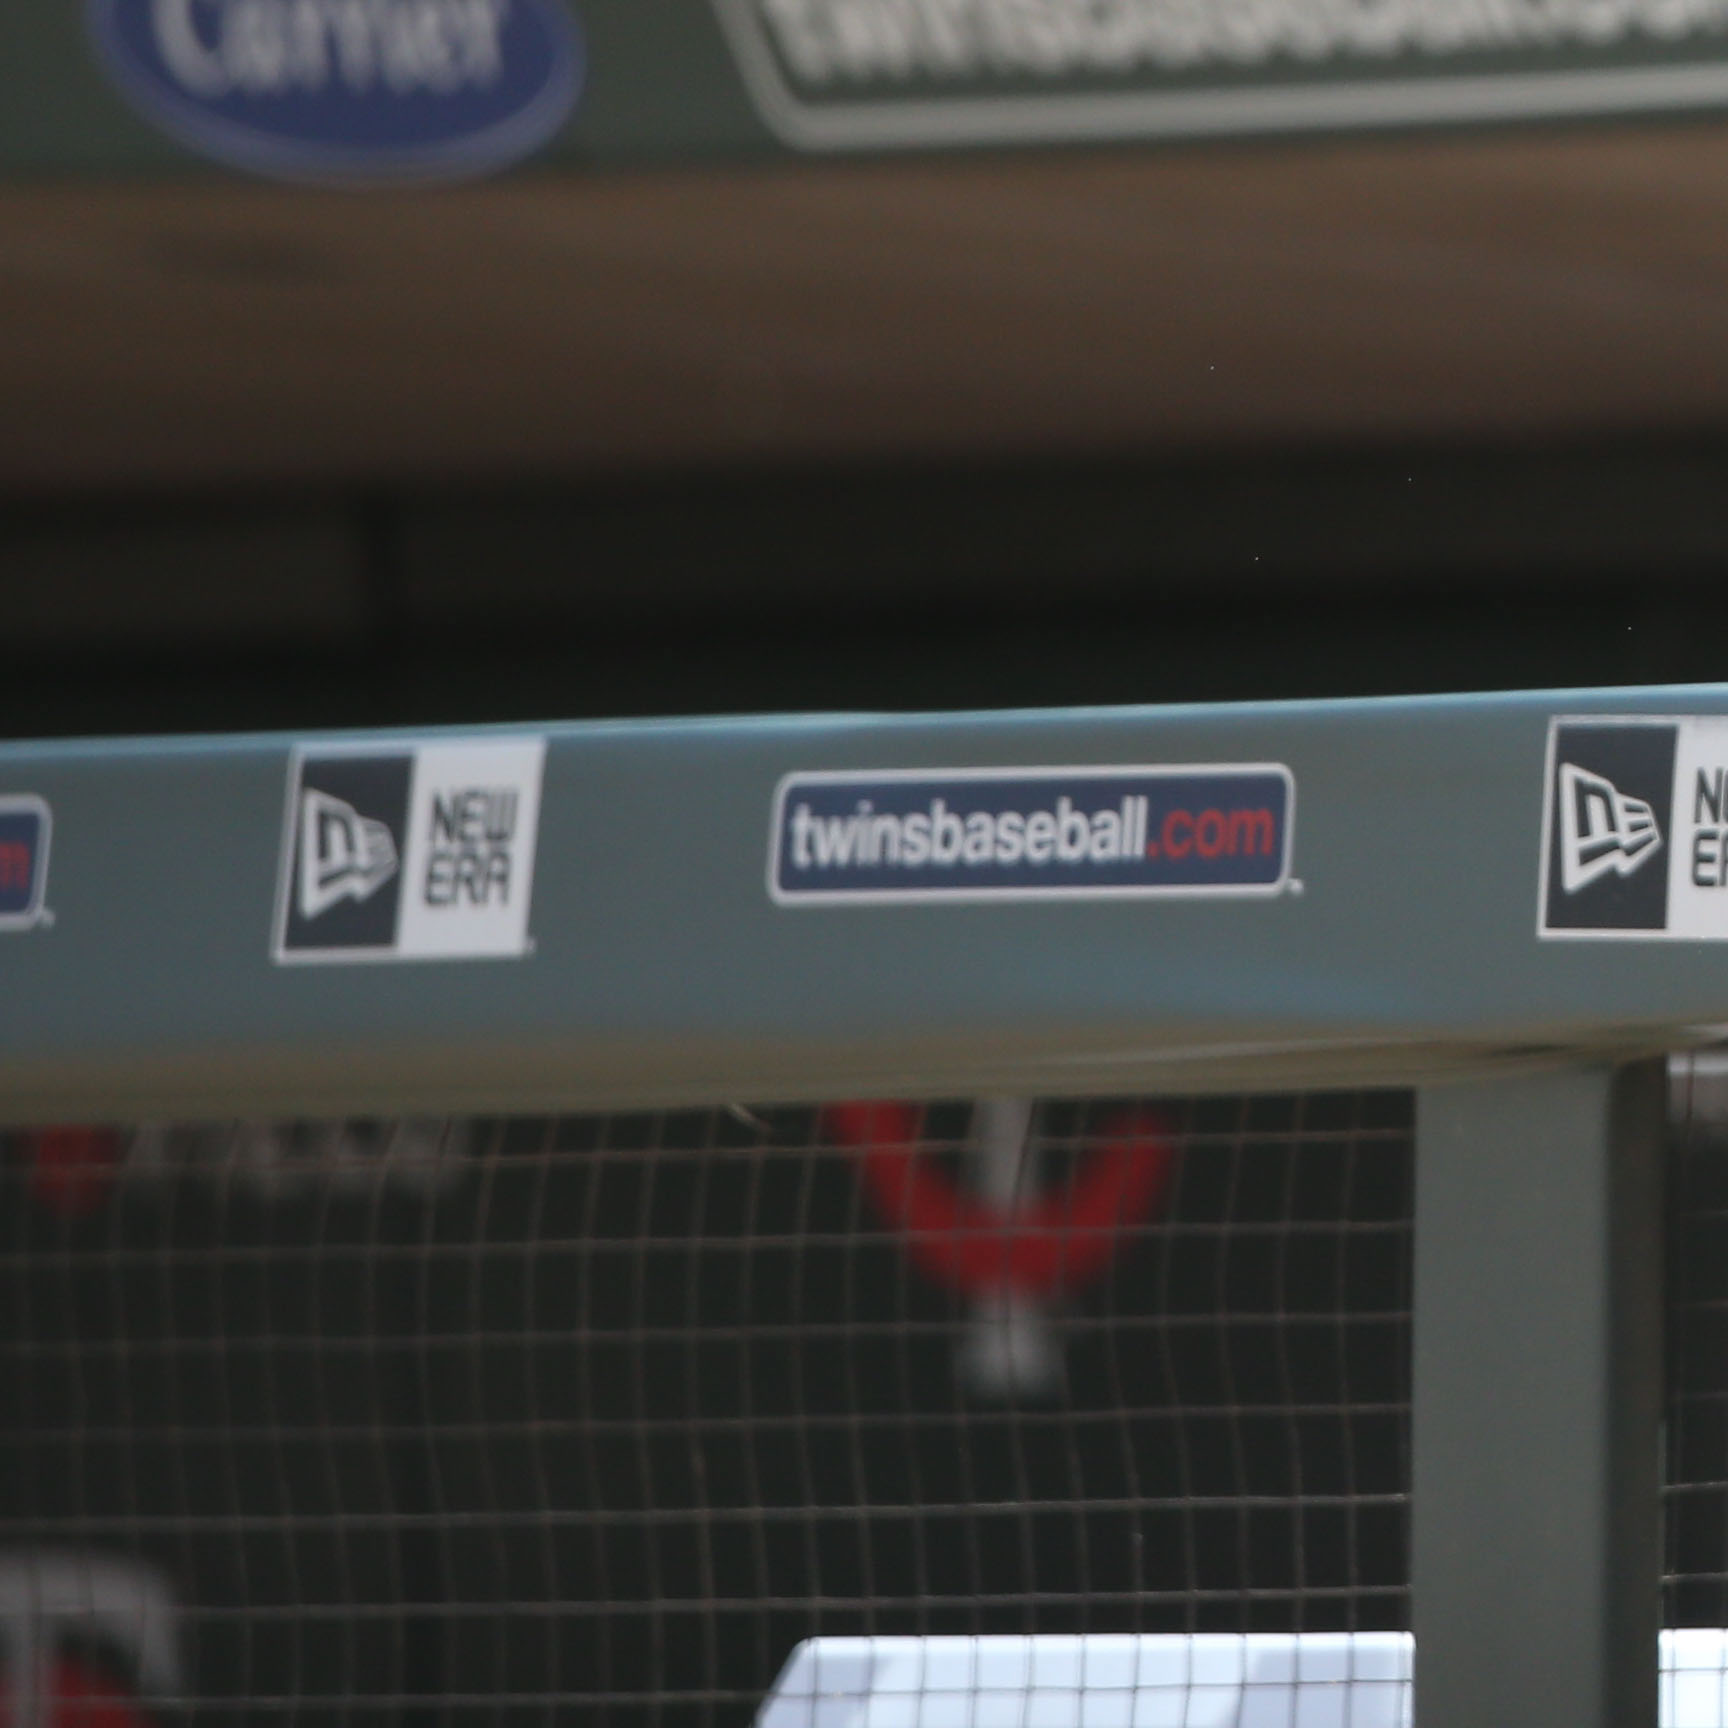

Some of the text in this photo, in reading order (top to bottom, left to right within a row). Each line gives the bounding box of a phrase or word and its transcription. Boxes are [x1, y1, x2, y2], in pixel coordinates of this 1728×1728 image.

[428, 787, 519, 845] NEW
[791, 795, 1275, 871] twinsbaseball.com
[423, 847, 513, 908] ERA
